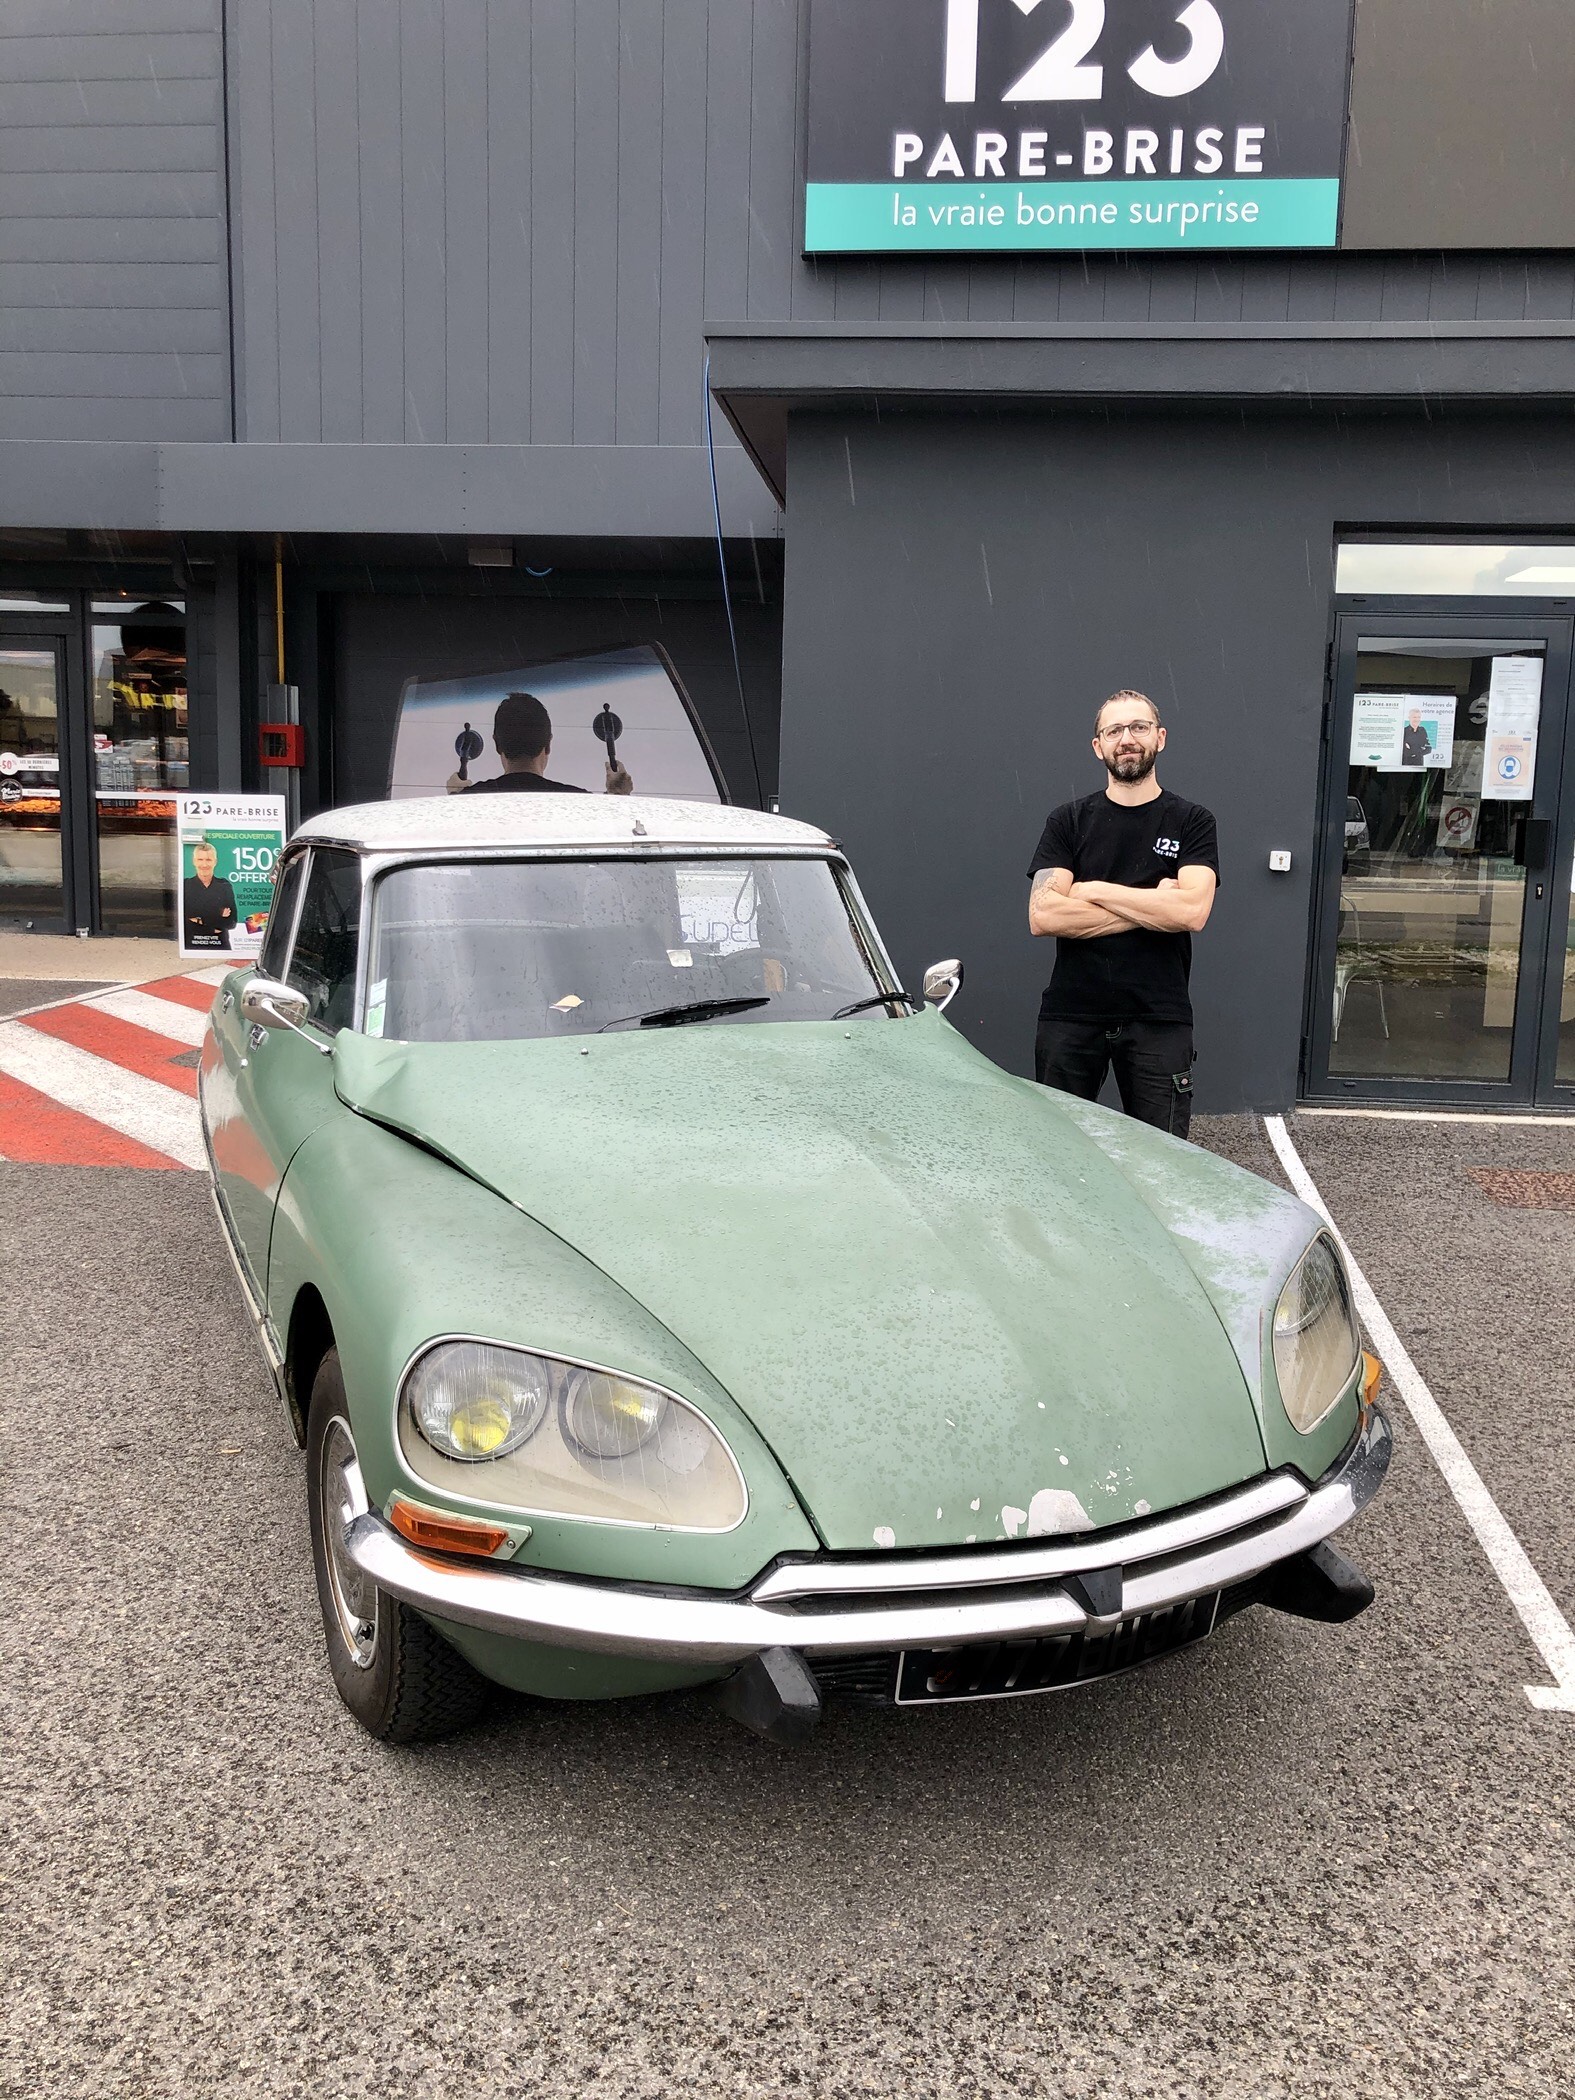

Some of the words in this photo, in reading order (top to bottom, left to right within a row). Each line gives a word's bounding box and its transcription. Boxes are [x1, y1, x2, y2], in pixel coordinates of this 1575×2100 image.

[943, 0, 1225, 103] 123
[894, 127, 1266, 178] PARE-BRISE
[893, 193, 917, 227] la
[928, 193, 1005, 226] vraie
[1017, 191, 1118, 226] bonne
[1129, 190, 1260, 237] surprise
[184, 800, 212, 815] 123
[216, 808, 279, 817] PARE-BRISE
[1155, 837, 1180, 852] 123
[1143, 1598, 1197, 1655] 94
